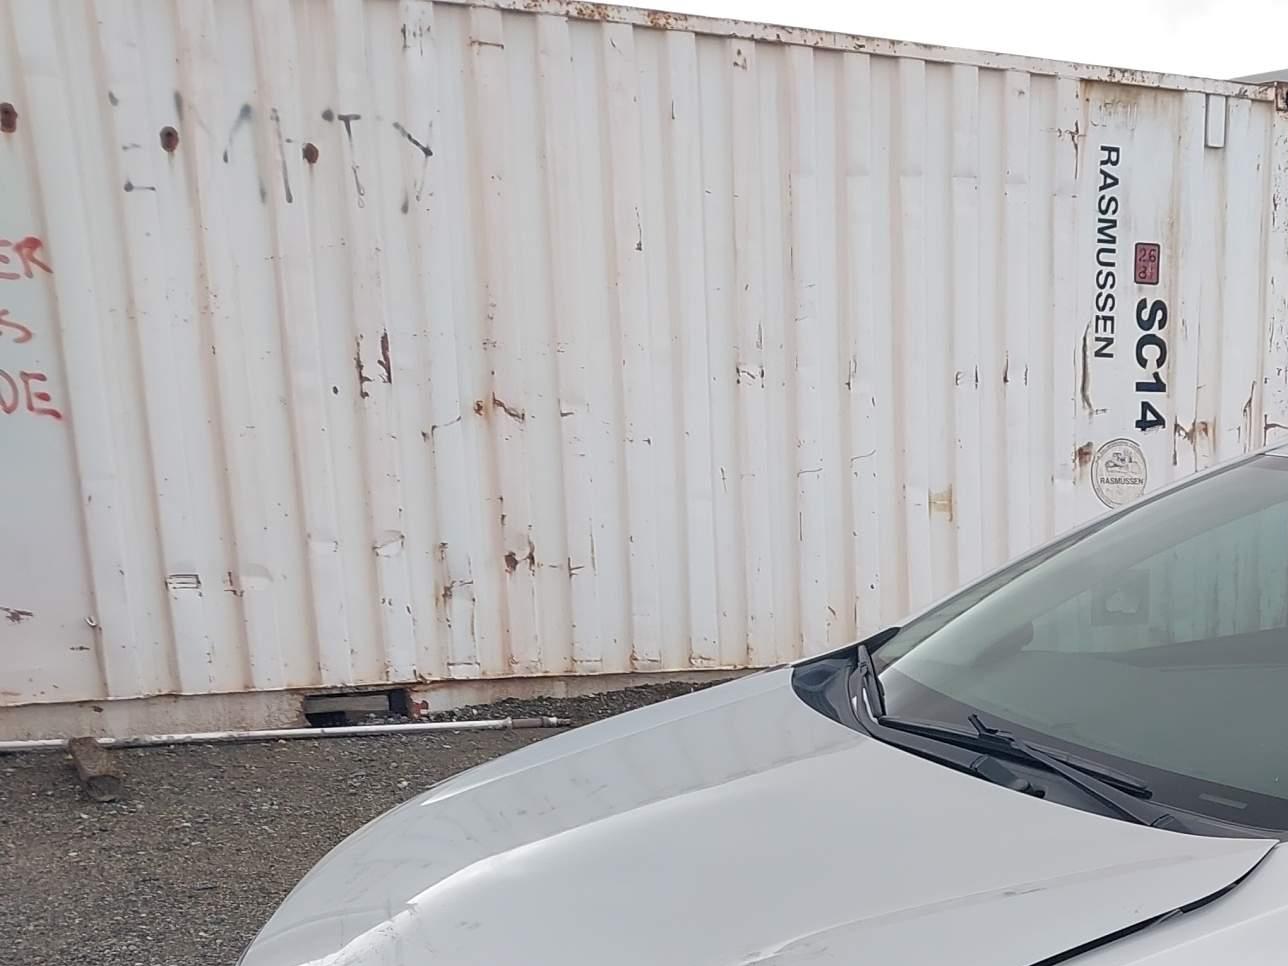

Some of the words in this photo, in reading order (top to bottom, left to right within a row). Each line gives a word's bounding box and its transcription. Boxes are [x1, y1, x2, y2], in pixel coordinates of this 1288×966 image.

[1094, 145, 1120, 359] RASMUSSEN
[1135, 297, 1168, 433] SC14
[1099, 476, 1144, 486] RASMUSSEN
